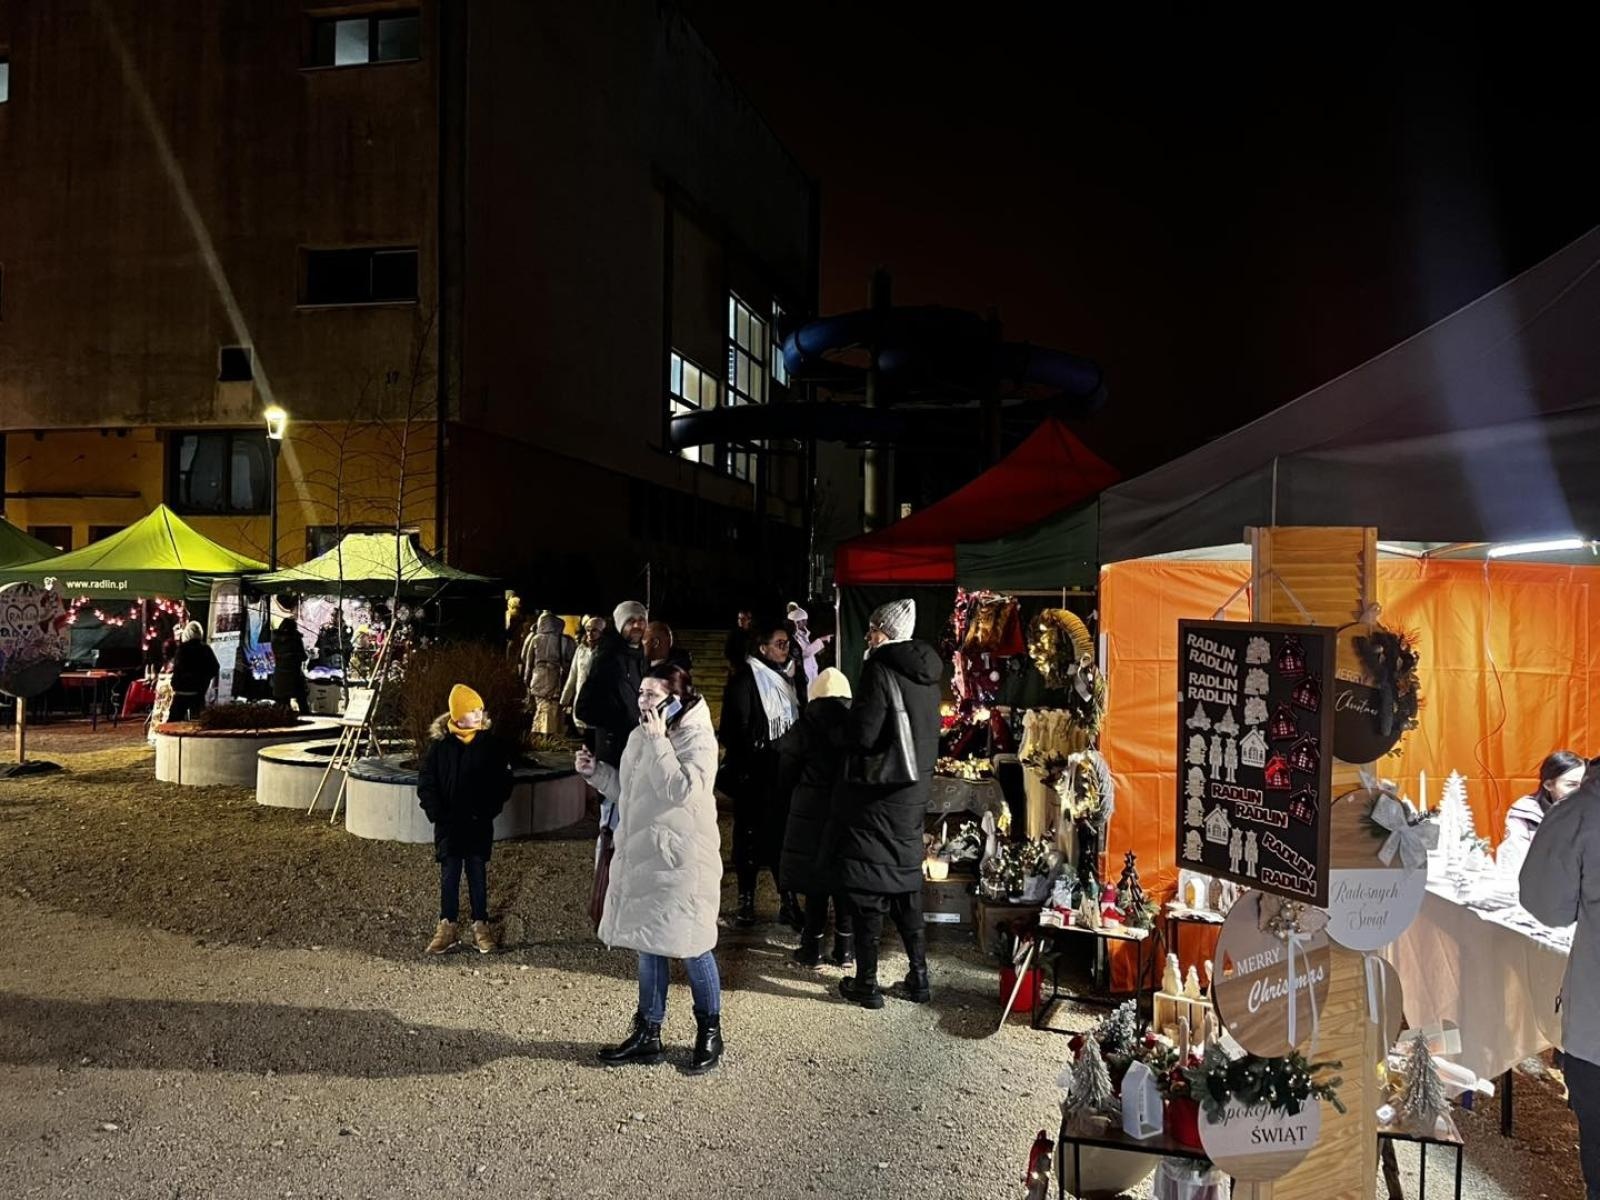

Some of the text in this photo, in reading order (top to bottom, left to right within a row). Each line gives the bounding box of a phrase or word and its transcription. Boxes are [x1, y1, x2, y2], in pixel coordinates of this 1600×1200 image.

[66, 580, 128, 590] www.radlin.pl
[1187, 633, 1236, 661] RADLIN
[1189, 648, 1238, 677] RADLIN
[1188, 671, 1238, 691] RADLIN
[1188, 686, 1237, 706] RADLIN
[1211, 783, 1263, 806] RADLIN
[1235, 802, 1288, 828] RADLIN
[1262, 831, 1316, 879] RADLIN
[1261, 867, 1317, 897] RADLIN
[1237, 947, 1281, 976] MERRY
[1248, 965, 1325, 1013] Chrismas
[1251, 1125, 1308, 1145] ŚWIĄT
